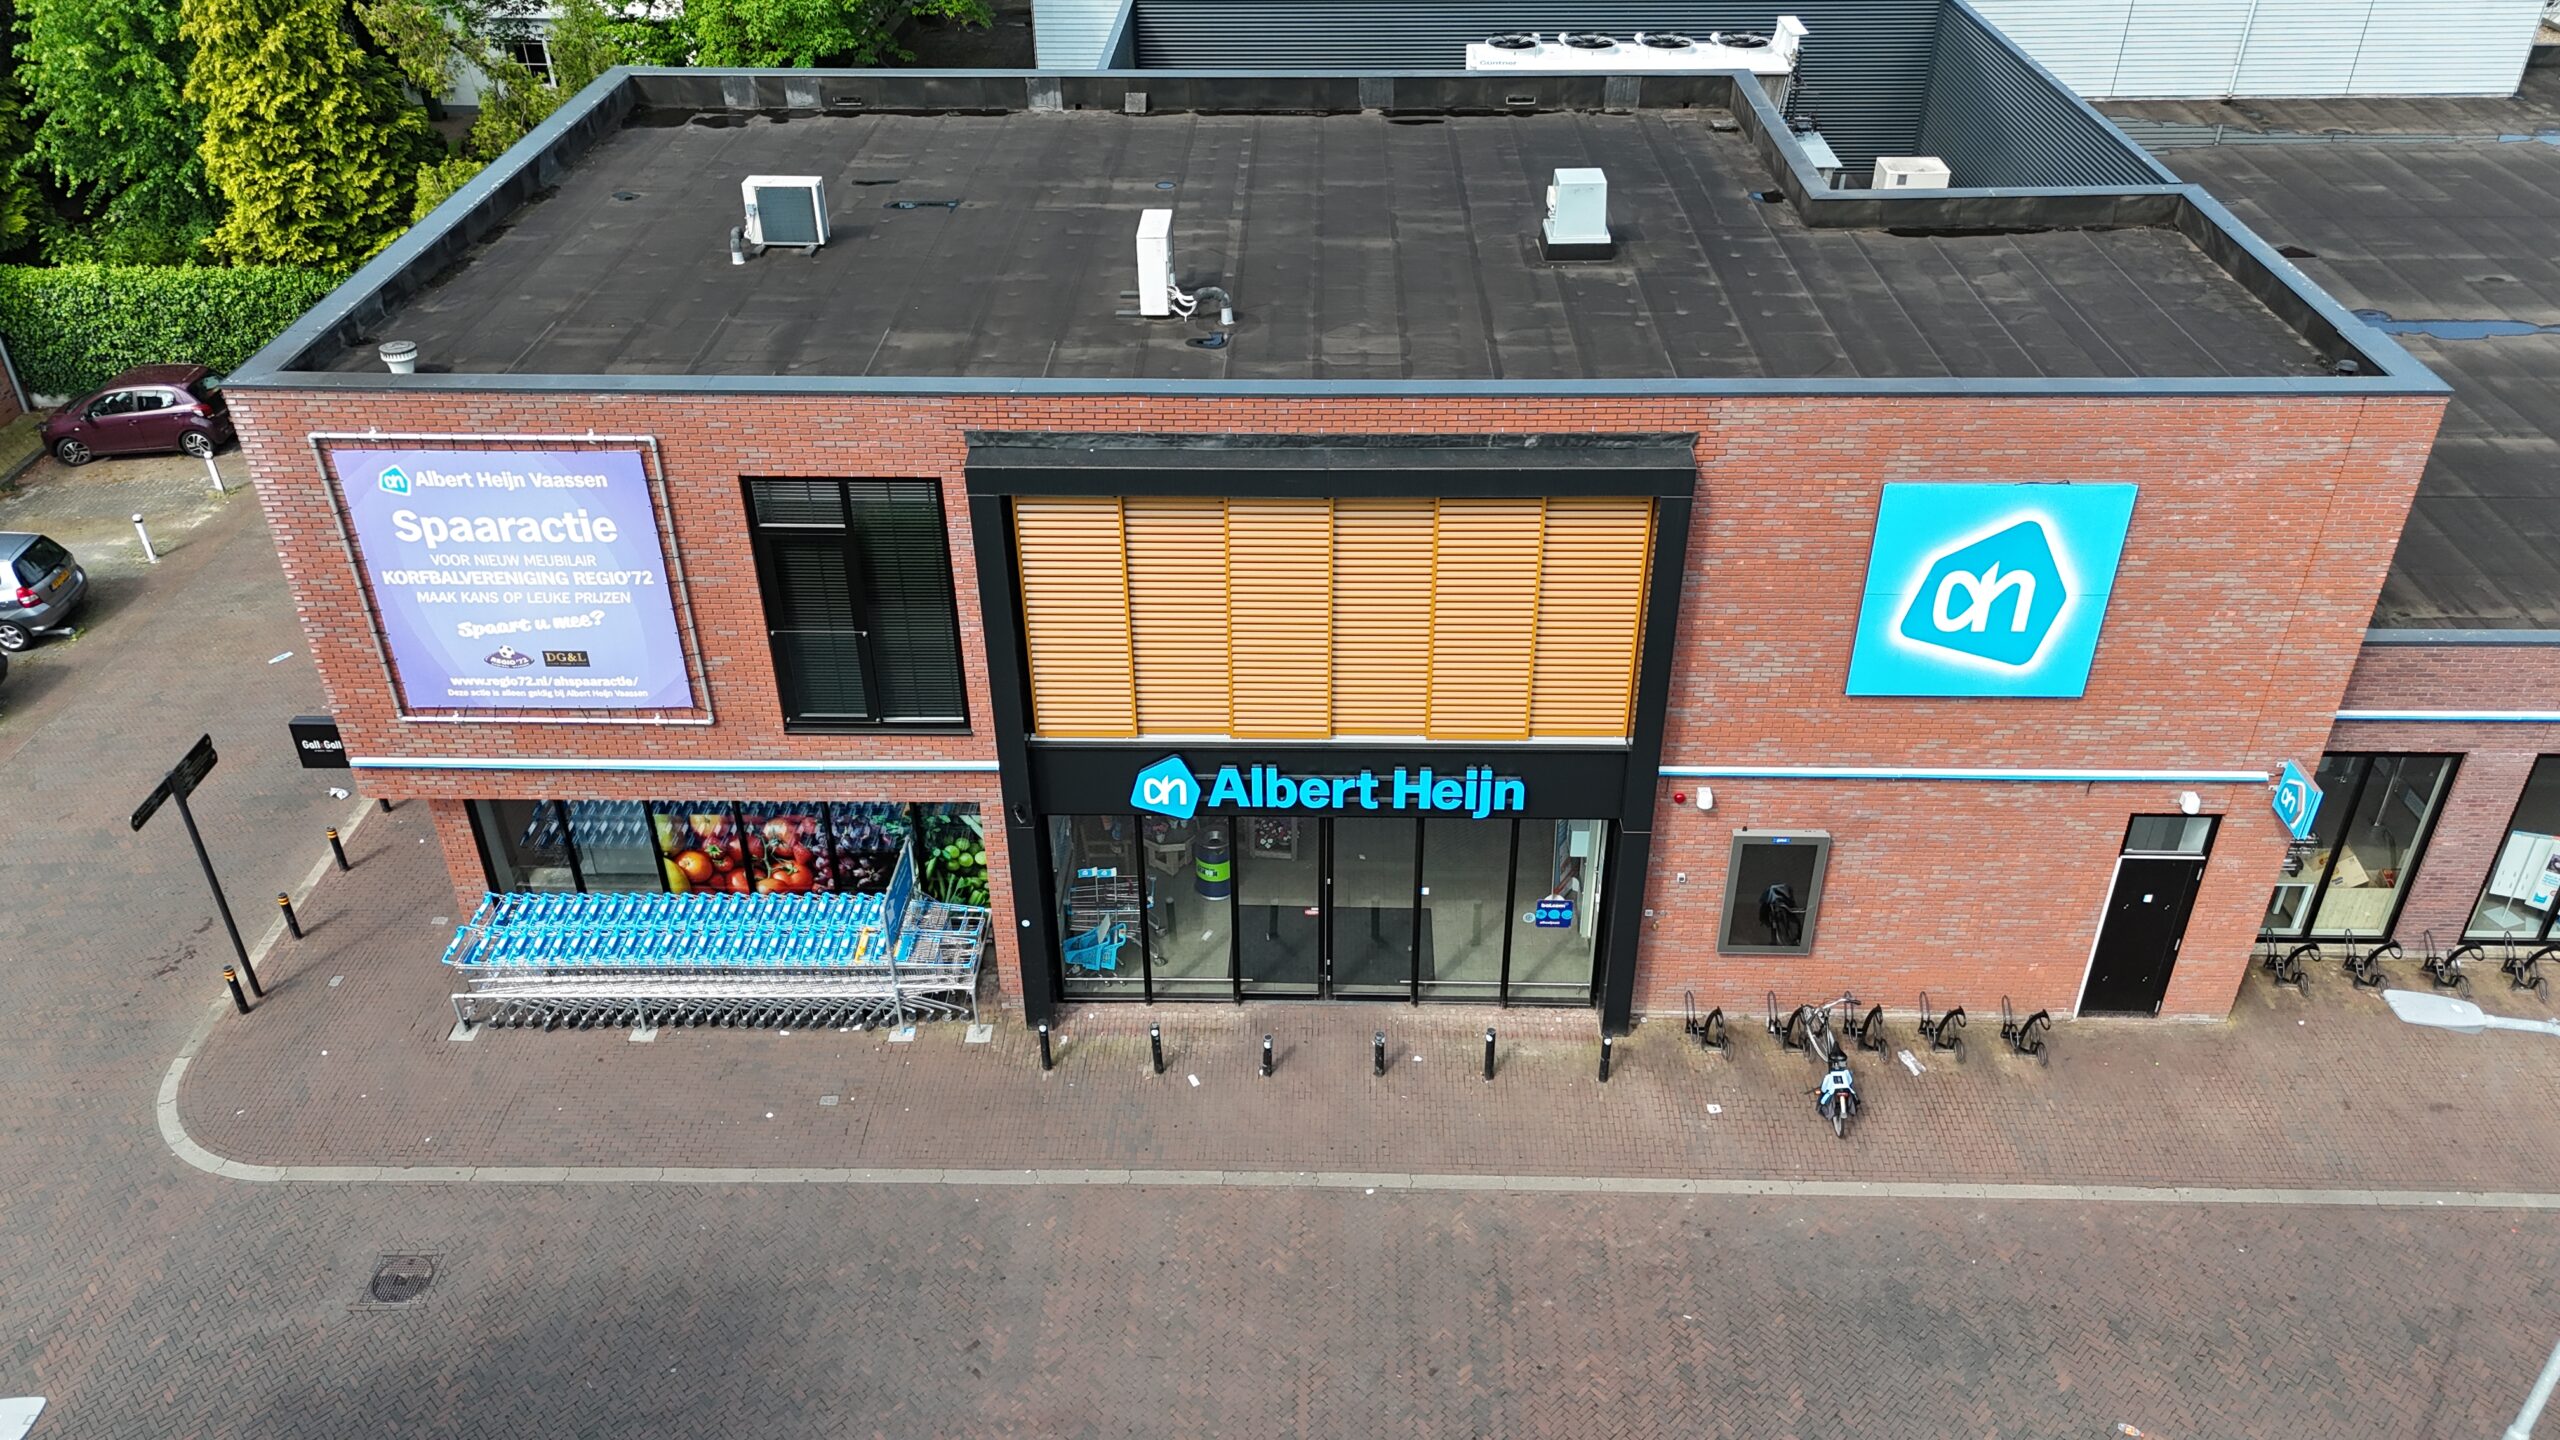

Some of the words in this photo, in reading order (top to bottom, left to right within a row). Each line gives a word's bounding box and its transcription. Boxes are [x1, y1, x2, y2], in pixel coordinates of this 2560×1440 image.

[416, 470, 474, 488] Albert
[476, 471, 526, 491] Heijn
[528, 472, 608, 488] Vaassen
[392, 508, 618, 549] Spaaractie
[430, 554, 471, 566] VOOR
[474, 554, 519, 567] NIEUW
[523, 554, 597, 567] MEUBILAIR
[382, 570, 570, 586] KORFBALVERENIGING
[572, 570, 654, 586] REGIO'72
[416, 591, 457, 604] MAAK
[461, 591, 499, 604] KANS
[503, 592, 522, 604] OP
[527, 592, 571, 604] LEUKE
[575, 592, 631, 604] PRIJZEN
[457, 618, 532, 639] Spaart
[535, 619, 551, 630] u
[552, 609, 605, 629] mee?
[546, 652, 587, 662] DG&L
[447, 688, 469, 697] Deze
[470, 688, 491, 697] actie
[492, 689, 500, 697] is
[502, 688, 526, 697] alleen
[528, 689, 554, 698] geldig
[554, 689, 566, 698] bij
[566, 689, 591, 697] Albert
[592, 689, 614, 698] Heijn
[302, 739, 321, 749] Gall
[323, 739, 343, 749] Gall
[1208, 766, 1379, 809] Albert
[1393, 767, 1525, 819] Heijn
